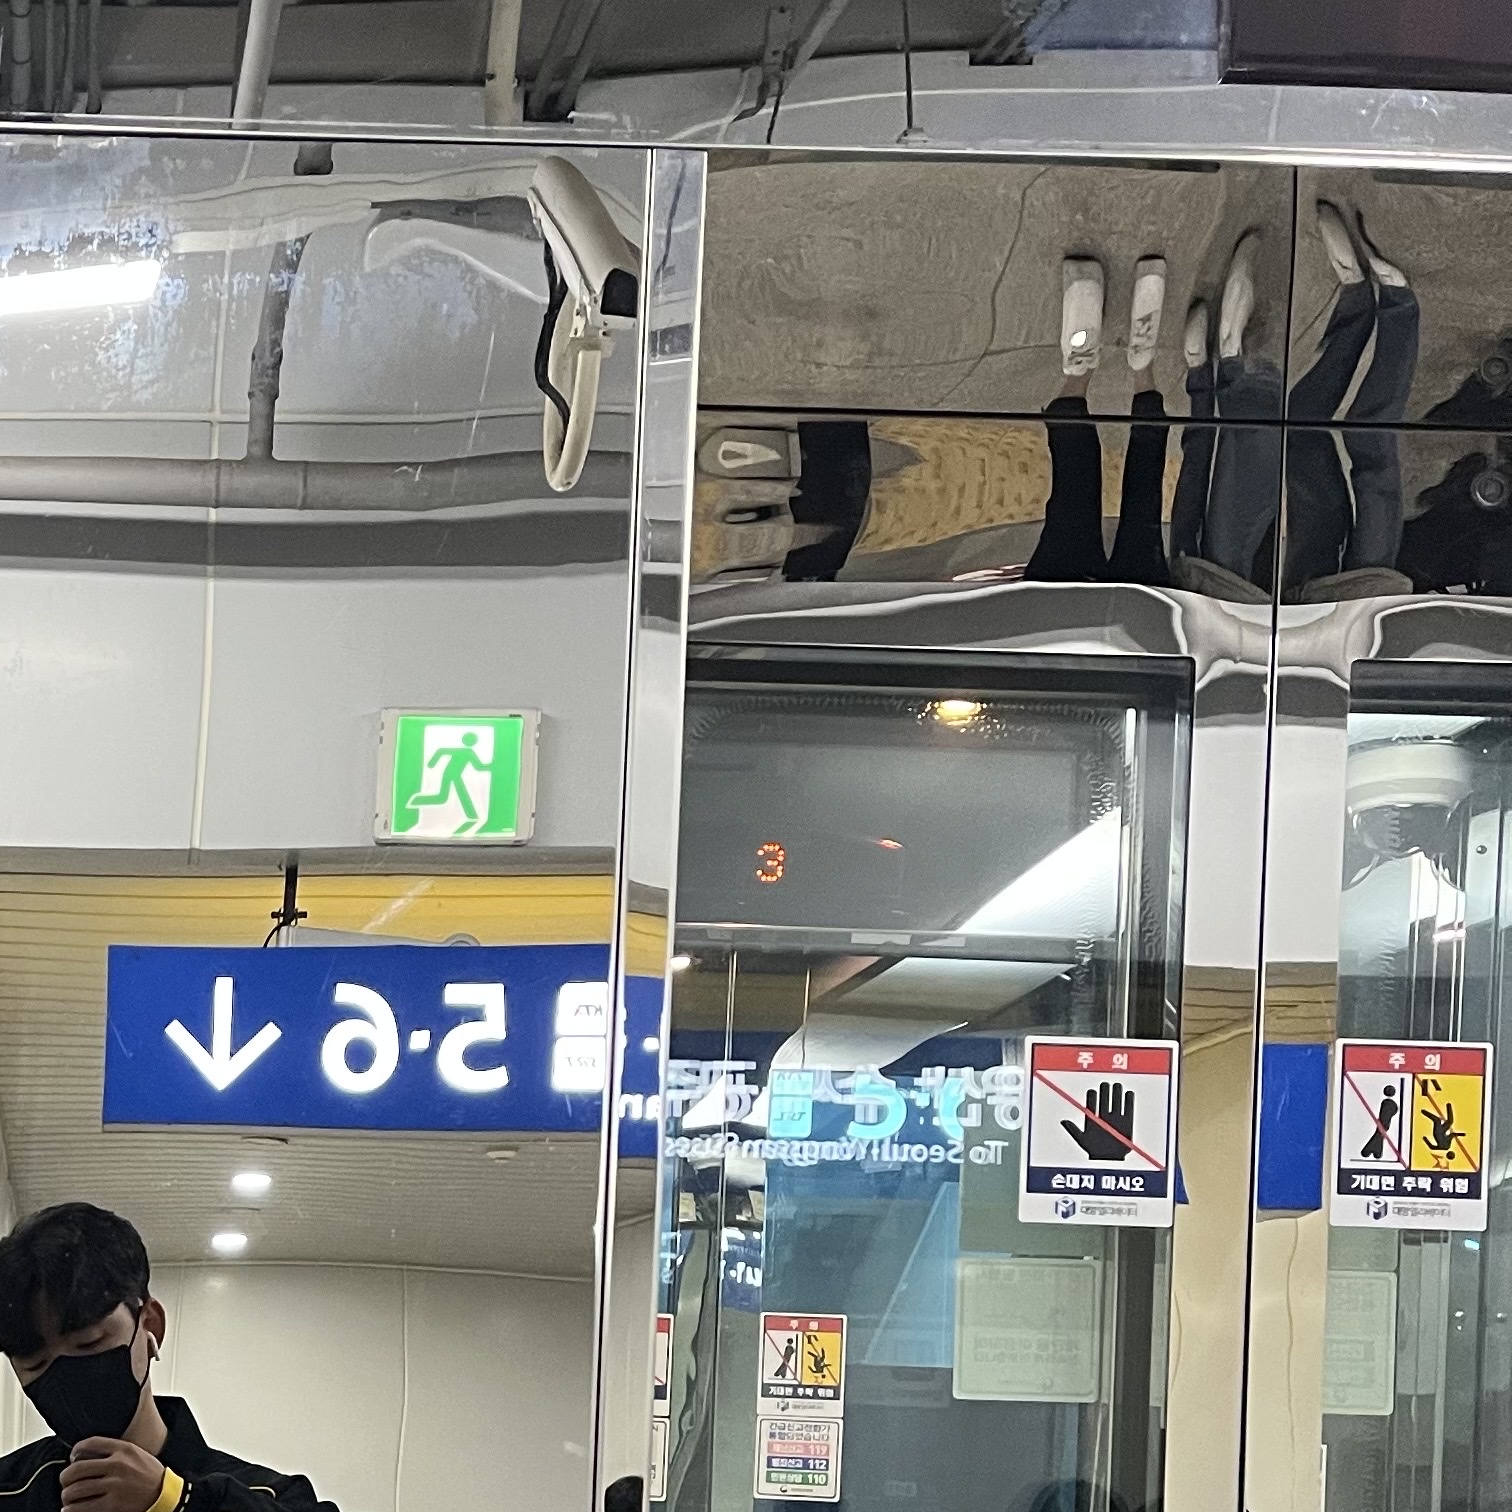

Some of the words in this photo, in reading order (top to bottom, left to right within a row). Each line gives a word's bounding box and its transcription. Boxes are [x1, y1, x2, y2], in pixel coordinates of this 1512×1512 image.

[756, 843, 785, 882] 3
[1051, 1173, 1095, 1190] 손대지
[1101, 1175, 1145, 1192] 마시오
[1351, 1174, 1395, 1191] 기대면
[1439, 1177, 1469, 1194] 위험
[809, 1444, 828, 1456] 119
[808, 1459, 827, 1470] 112
[808, 1473, 827, 1485] 110
